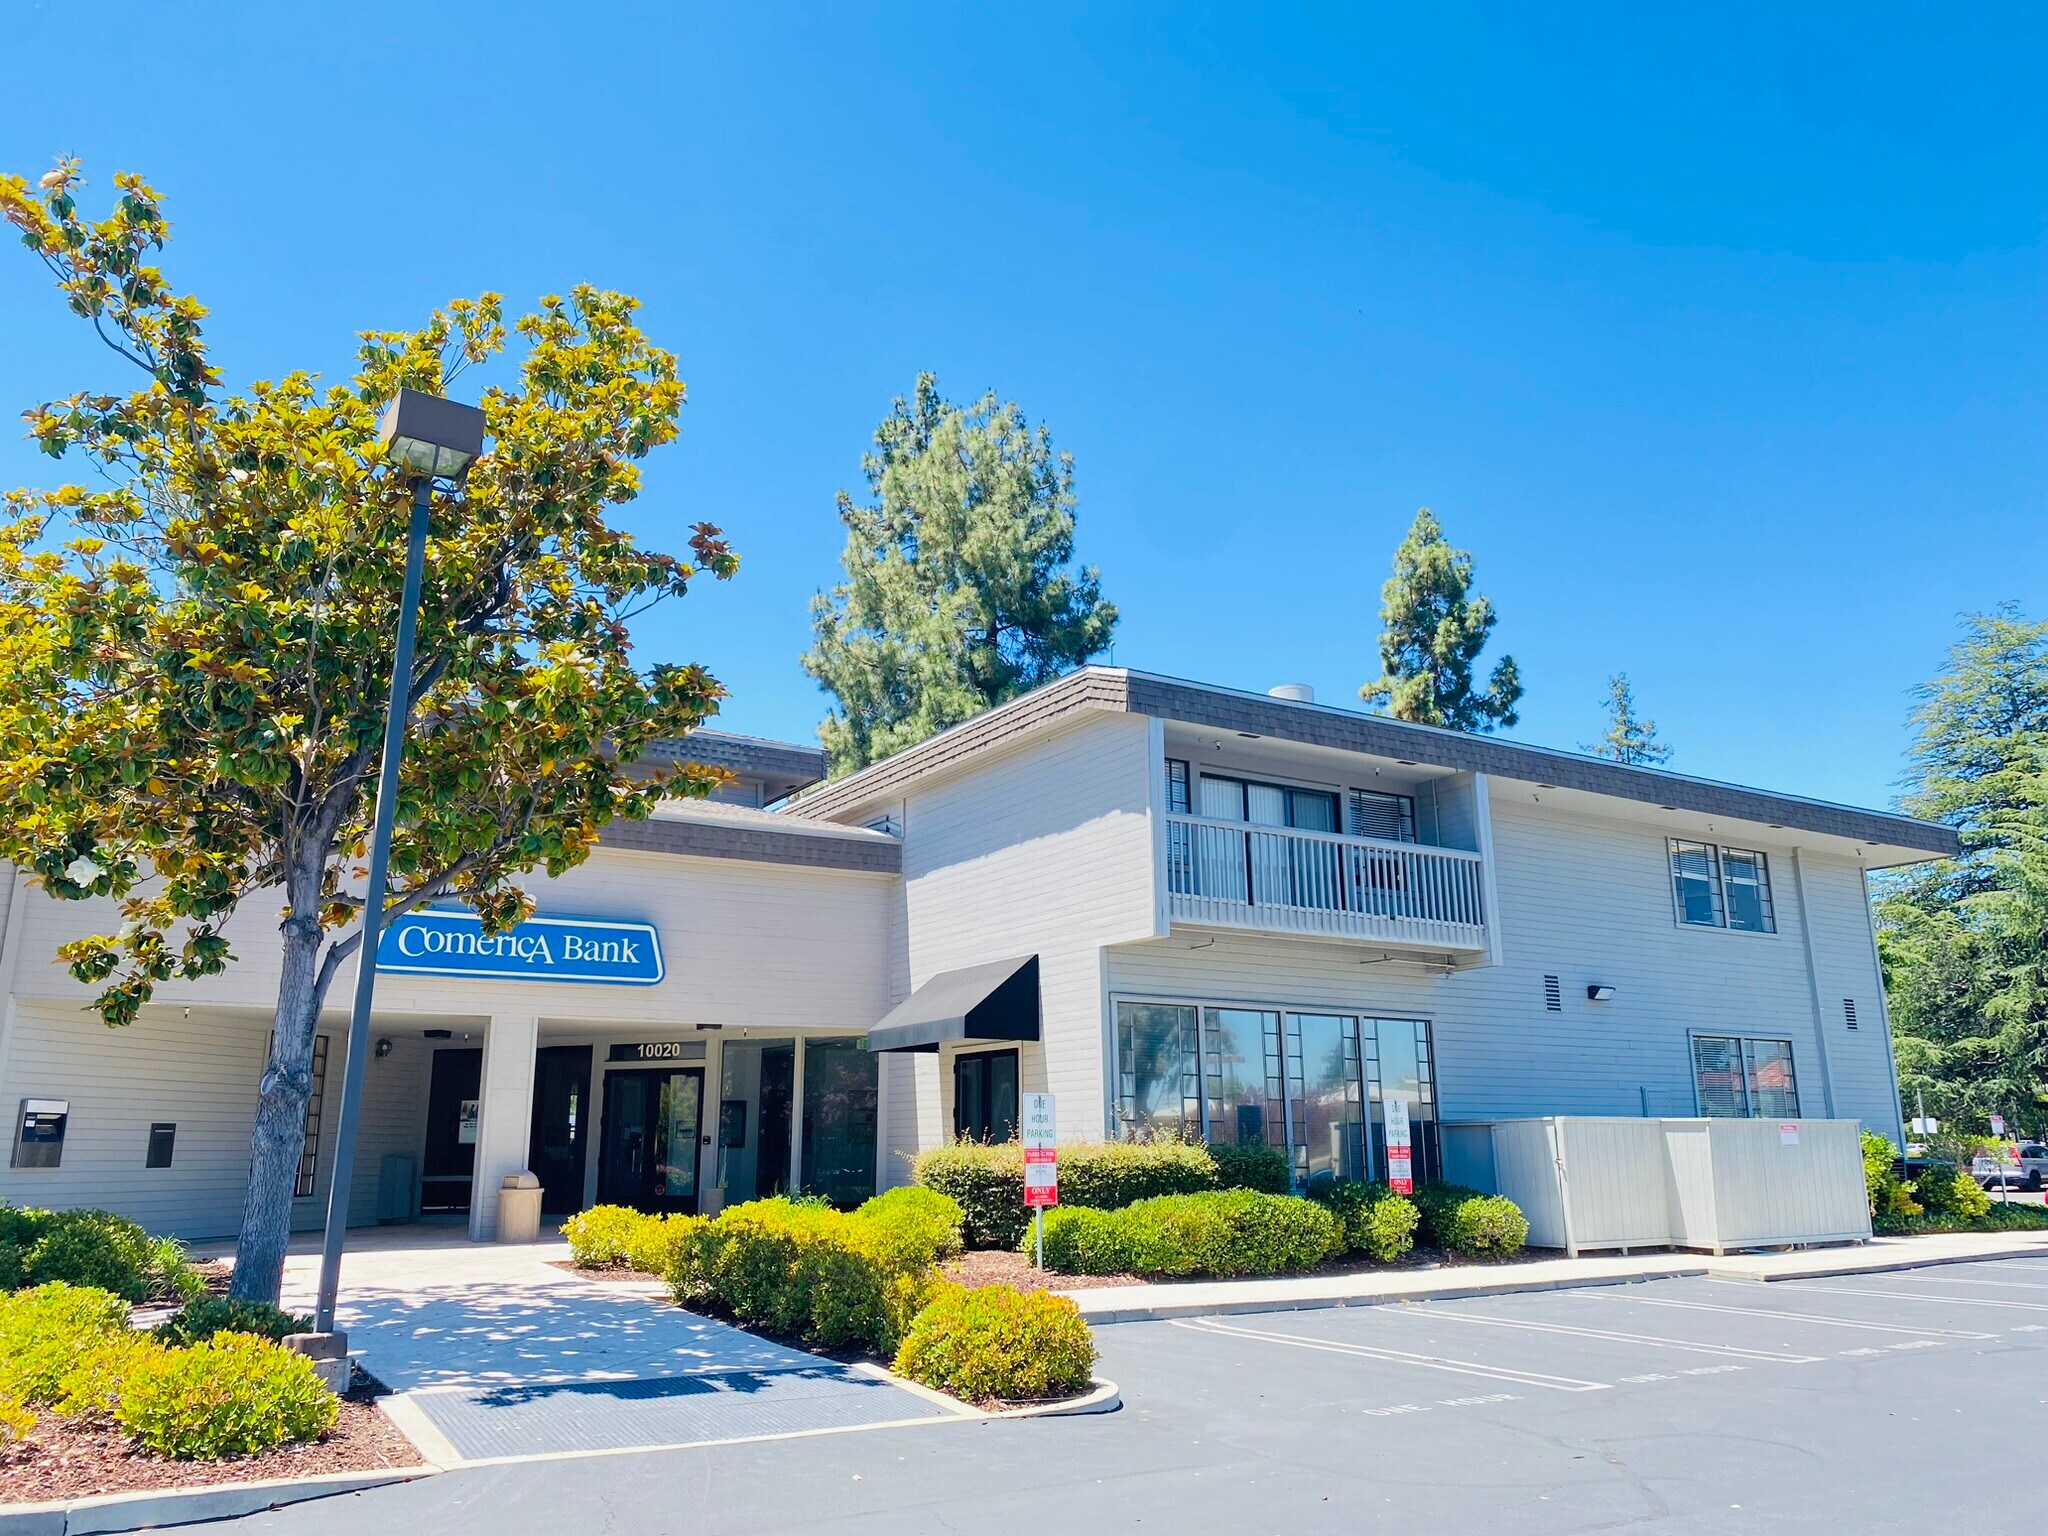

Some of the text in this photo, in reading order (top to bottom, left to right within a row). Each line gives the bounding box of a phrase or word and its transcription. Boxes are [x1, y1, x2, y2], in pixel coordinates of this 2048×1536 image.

[562, 934, 640, 964] Bank
[637, 1043, 681, 1058] 10020
[1033, 1099, 1046, 1109] ONE
[1031, 1114, 1049, 1124] HOUR
[1391, 1117, 1404, 1125] HOUR
[1026, 1129, 1054, 1138] PARKING
[1388, 1129, 1408, 1138] PARKING
[1362, 1393, 1525, 1416] ONE HOUR
